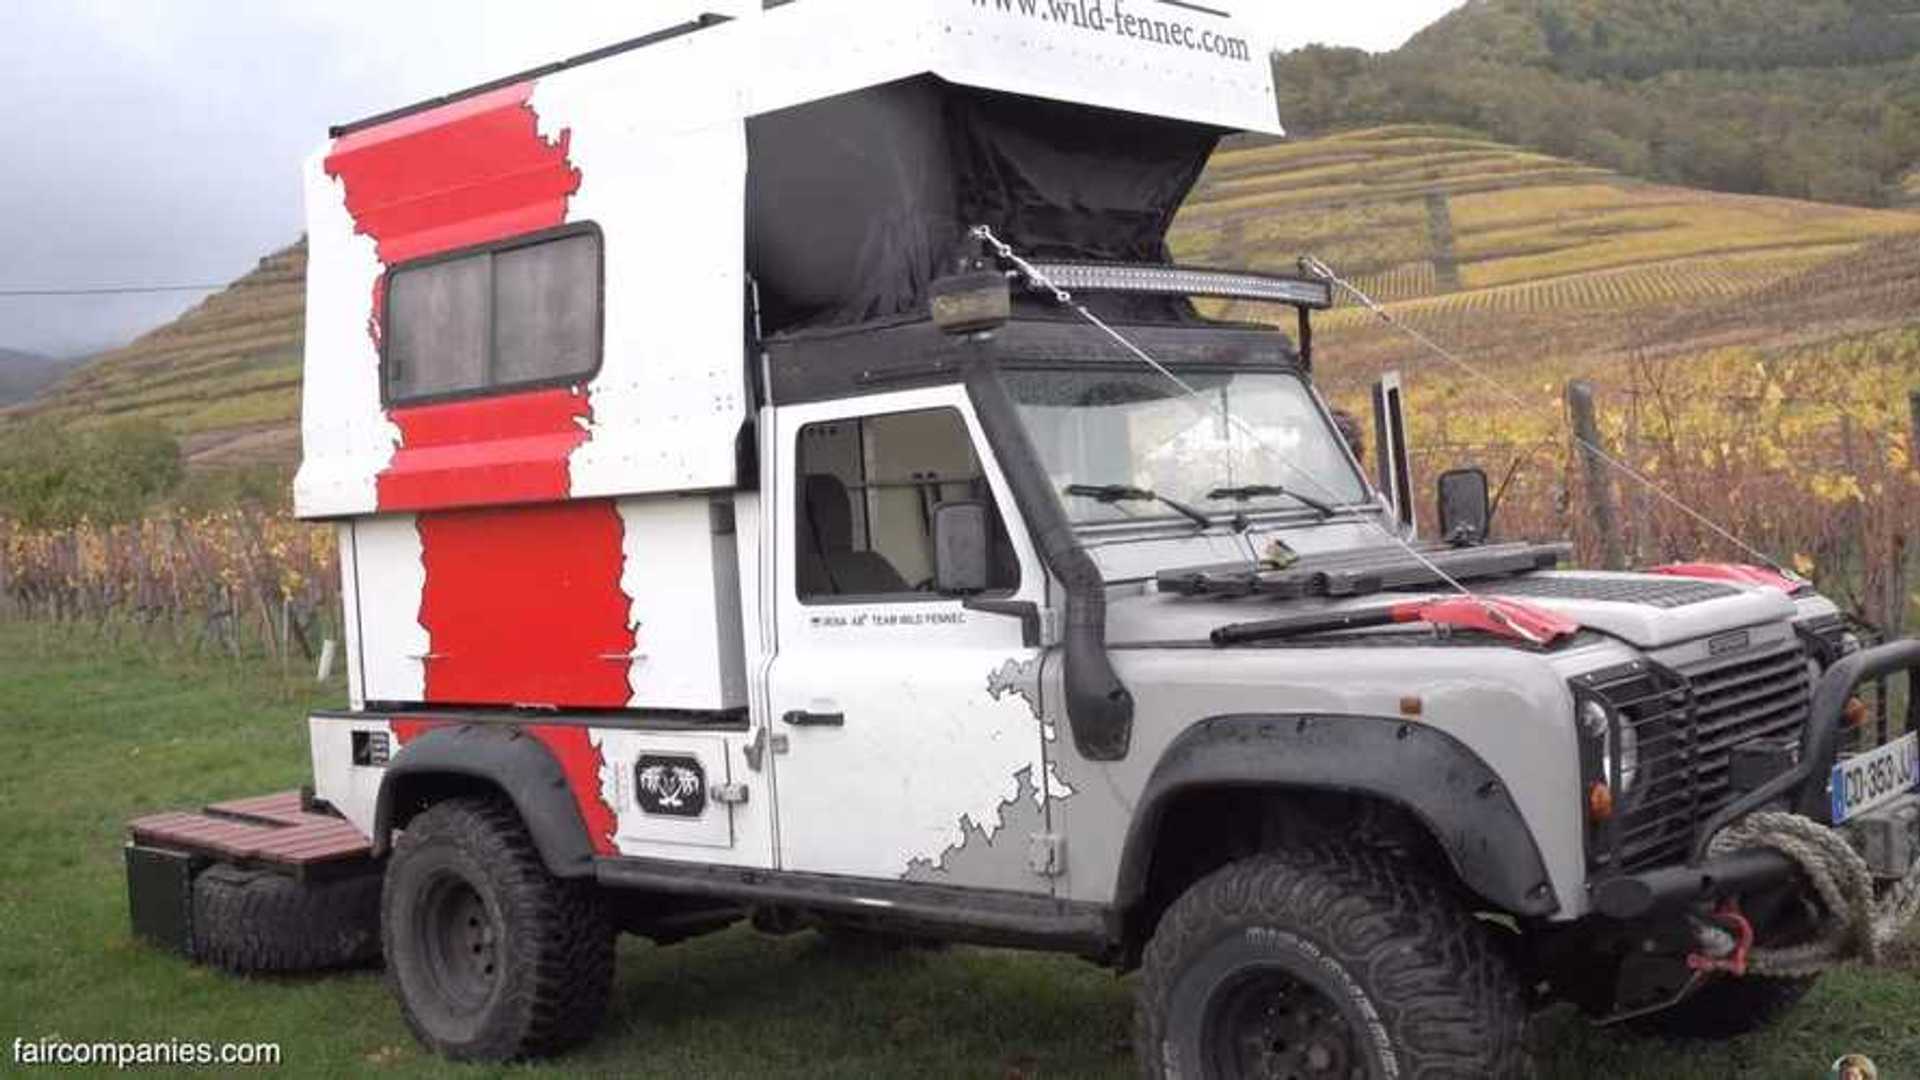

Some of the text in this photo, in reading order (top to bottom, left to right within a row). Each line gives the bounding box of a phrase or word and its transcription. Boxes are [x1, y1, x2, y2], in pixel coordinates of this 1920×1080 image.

[971, 0, 1250, 61] ww.wild-fennec.com
[872, 614, 897, 625] TEAM
[925, 612, 966, 624] FENNEC
